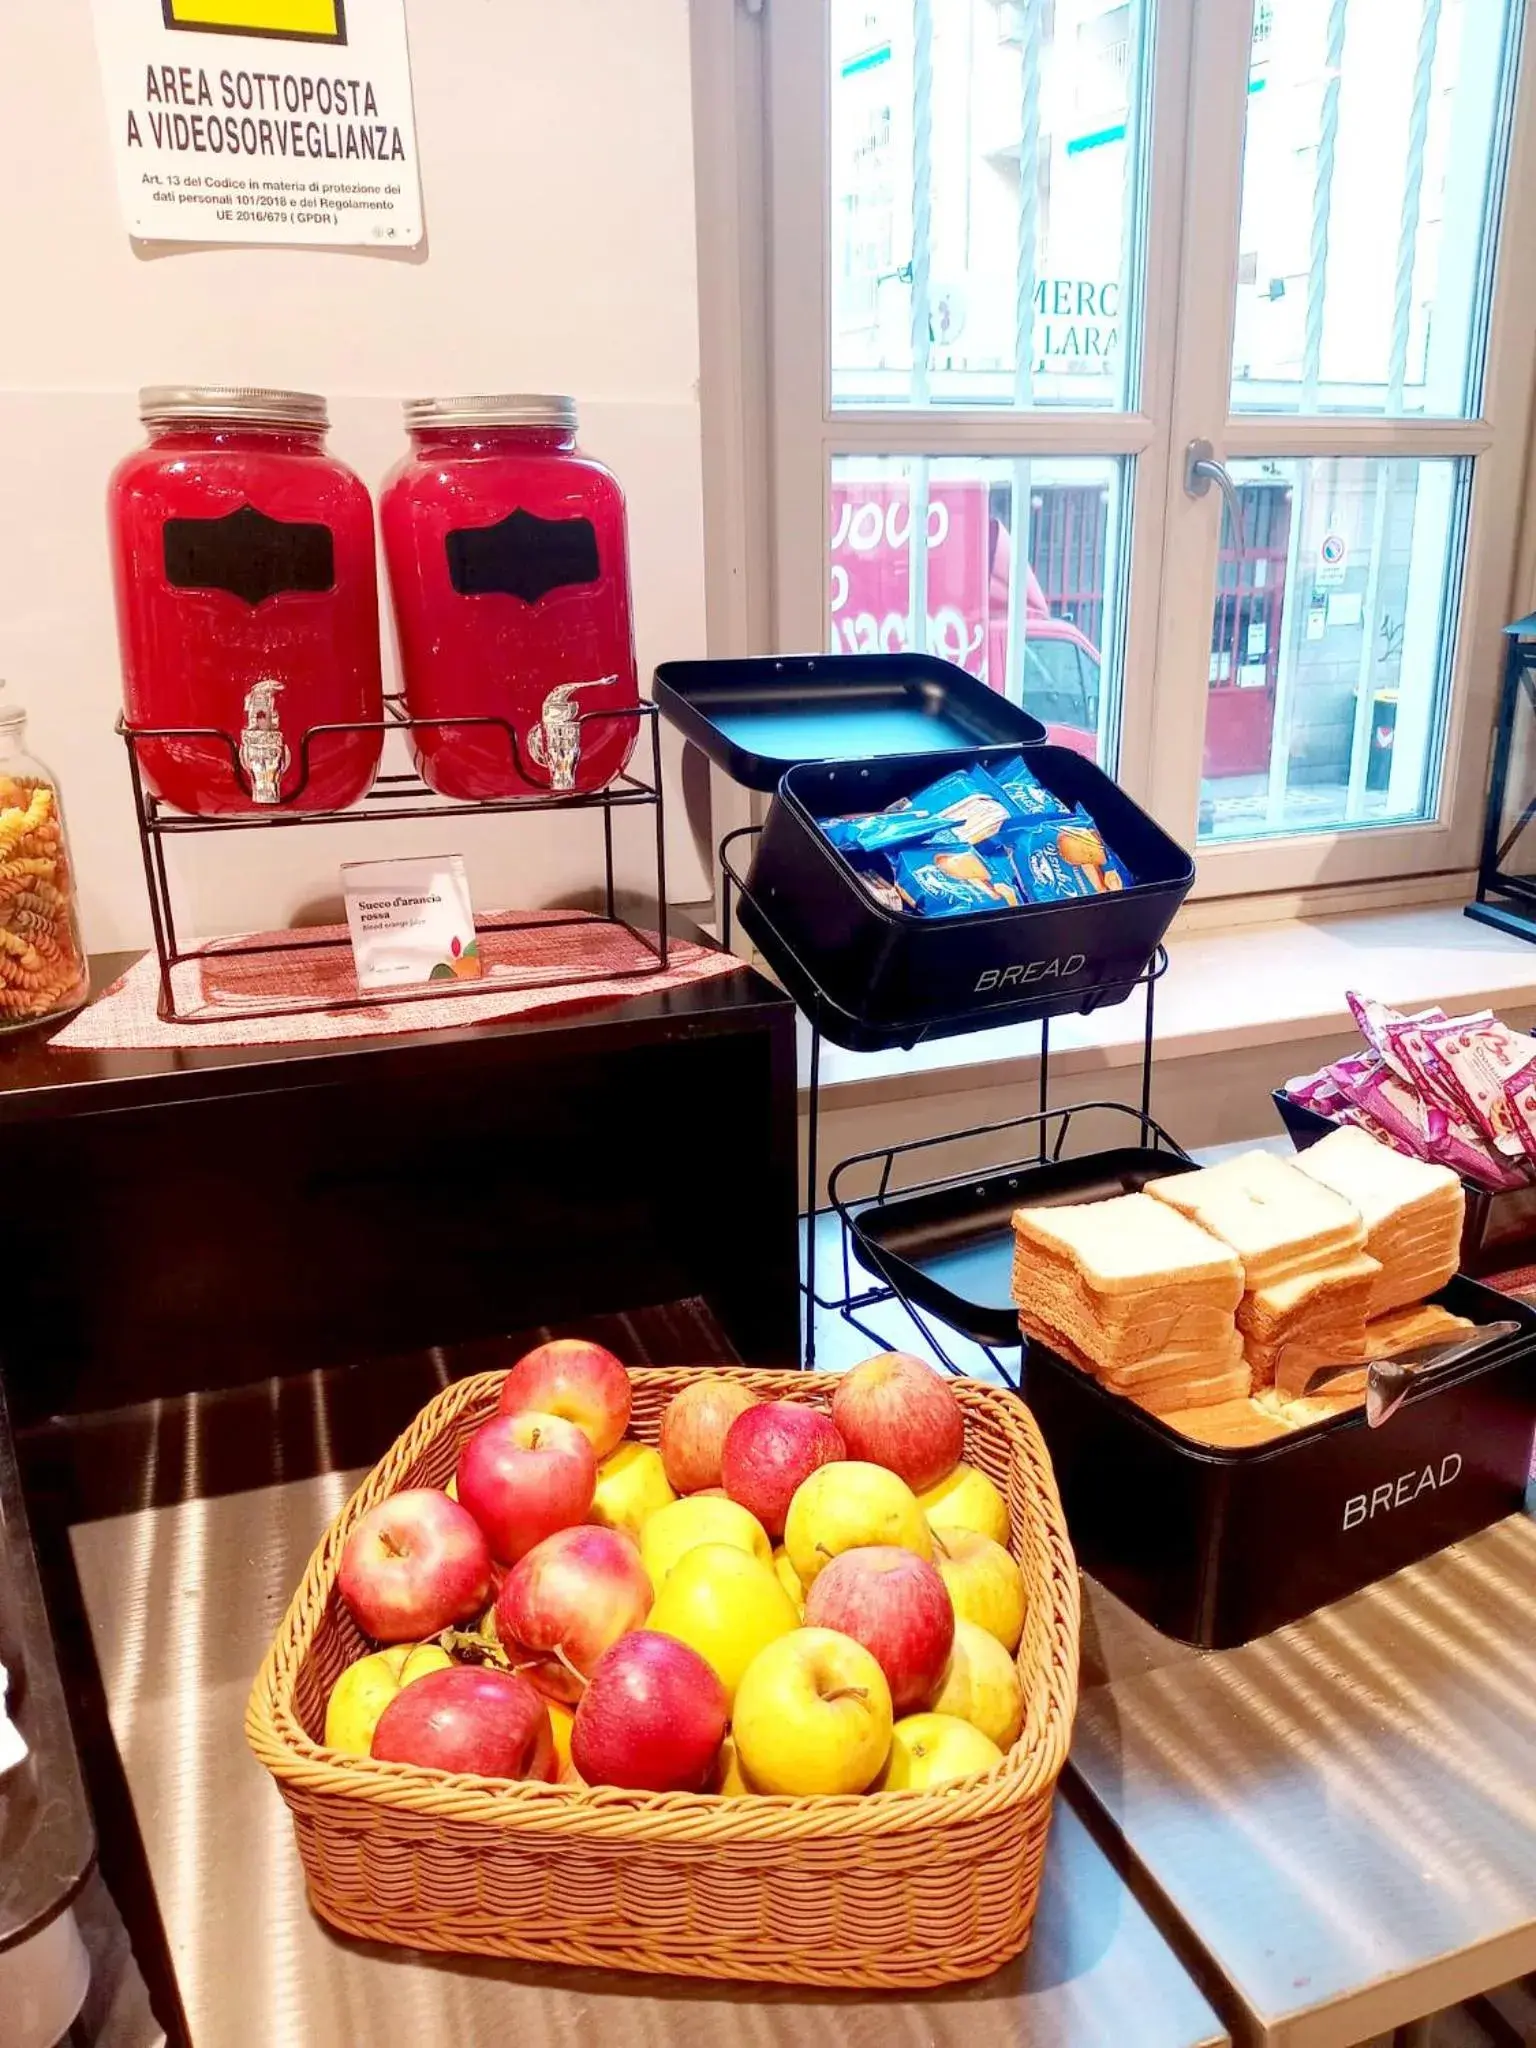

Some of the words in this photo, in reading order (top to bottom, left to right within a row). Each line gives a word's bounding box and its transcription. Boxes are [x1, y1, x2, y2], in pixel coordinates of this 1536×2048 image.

[146, 64, 213, 106] AREA
[220, 69, 379, 117] SOTTOPOSTA
[127, 110, 143, 148] A
[148, 112, 406, 161] VIDEOSORVEGLIANZA
[142, 172, 163, 185] Art.
[167, 175, 181, 186] 13
[184, 176, 201, 187] del
[204, 176, 246, 189] Codice
[249, 178, 259, 189] in
[262, 181, 305, 191] materia
[309, 181, 319, 192] di
[322, 181, 381, 195] protezione
[152, 190, 176, 202] dati
[178, 193, 233, 205] personali
[236, 195, 287, 207] 101/2018
[290, 199, 297, 207] e
[320, 199, 394, 211] Regolamento
[216, 209, 233, 221] UE
[236, 210, 288, 223] 2016/679
[359, 900, 391, 911] Succo
[393, 894, 442, 907] d'arancia
[361, 911, 390, 922] rossa
[974, 954, 1086, 992] BREAD
[1343, 1453, 1462, 1531] BREAD
